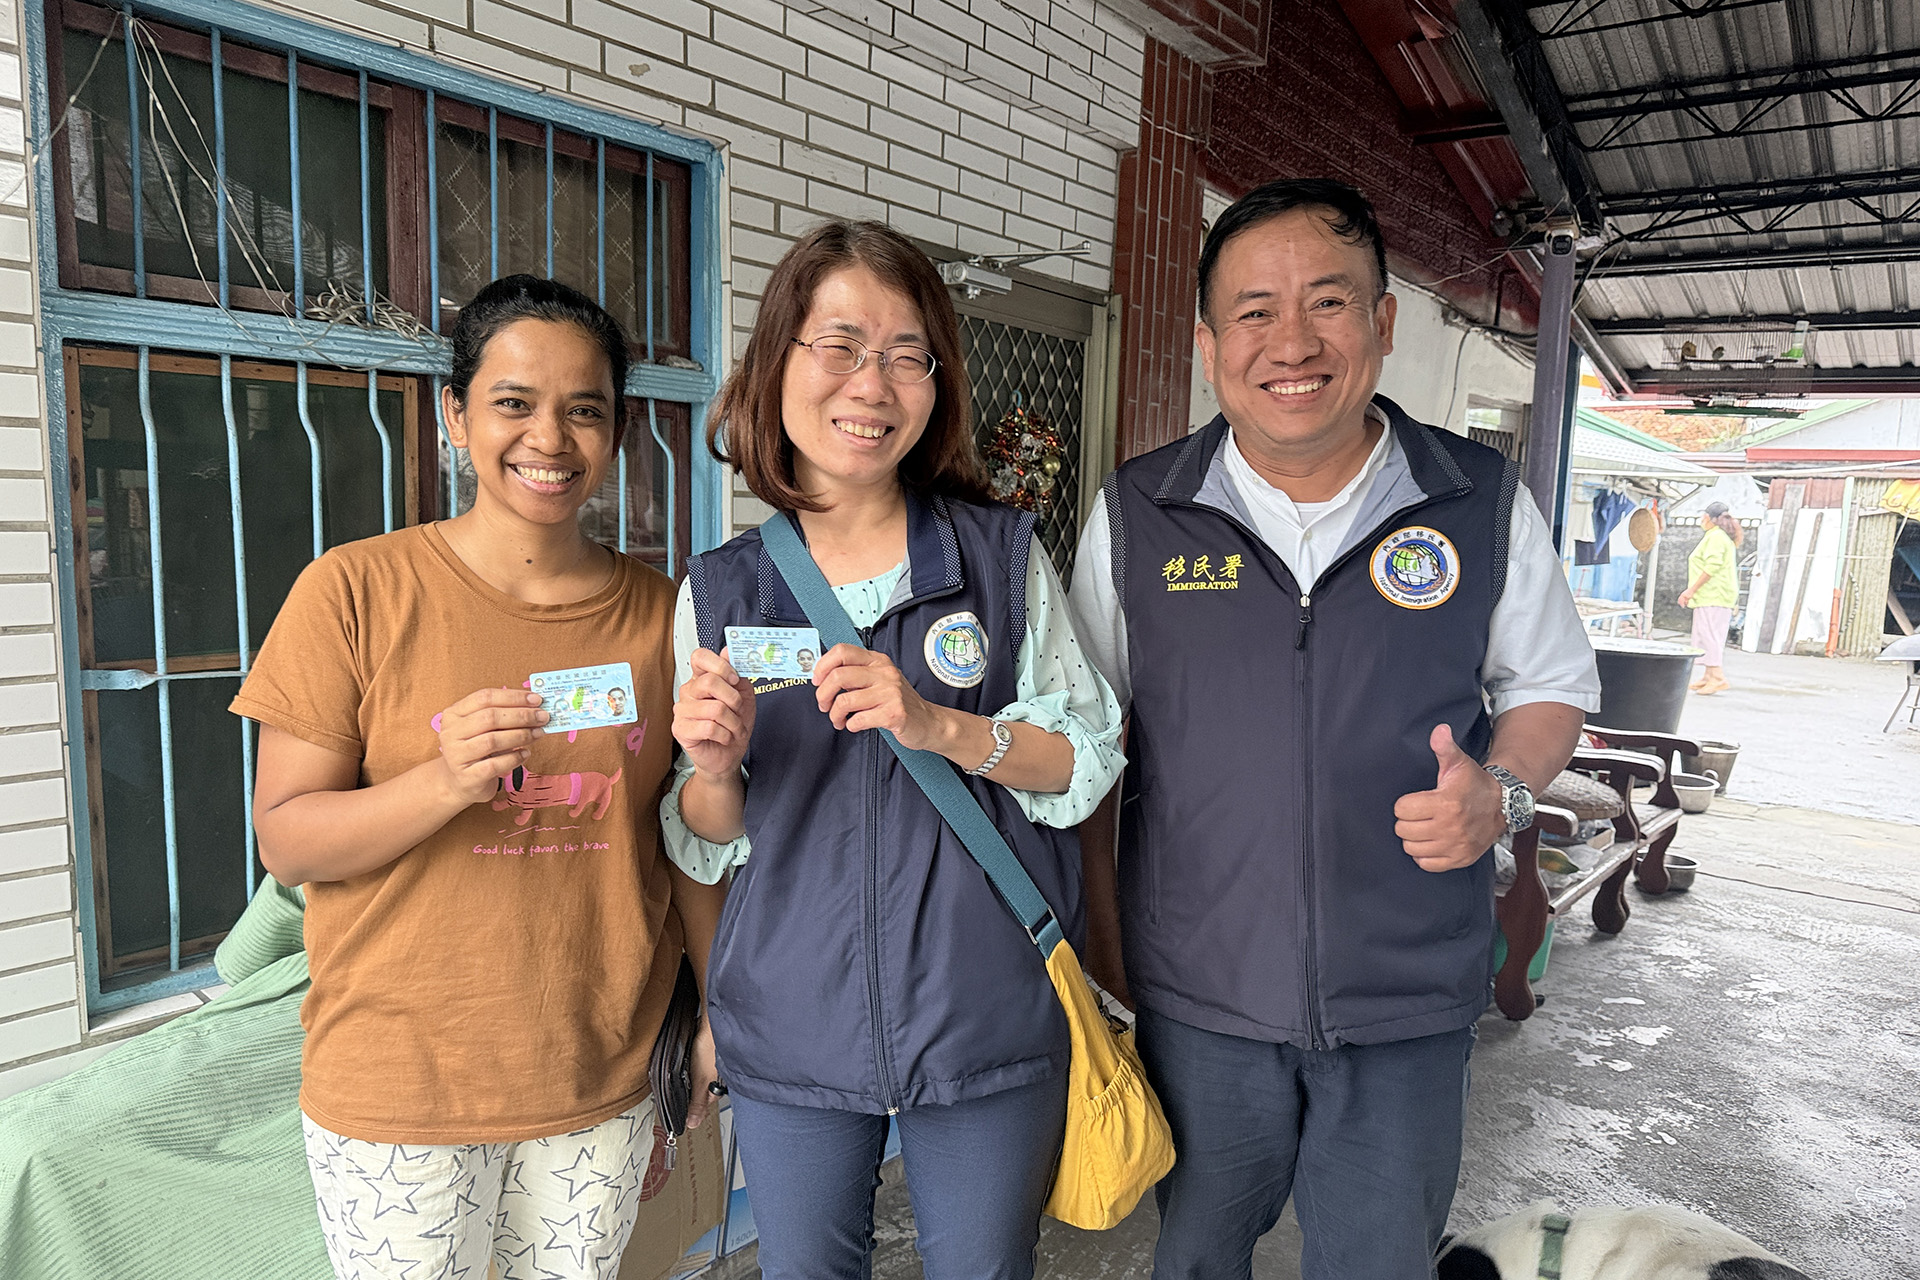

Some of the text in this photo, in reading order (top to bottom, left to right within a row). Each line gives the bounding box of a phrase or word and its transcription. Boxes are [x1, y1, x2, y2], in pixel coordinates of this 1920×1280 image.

[1161, 553, 1245, 582] 移民署
[1166, 580, 1239, 592] IMMIGRATION
[1378, 573, 1455, 604] National Immigration Agency
[930, 658, 950, 680] National
[753, 678, 808, 695] MIGRATION
[473, 841, 610, 857] Good luck favors the brave
